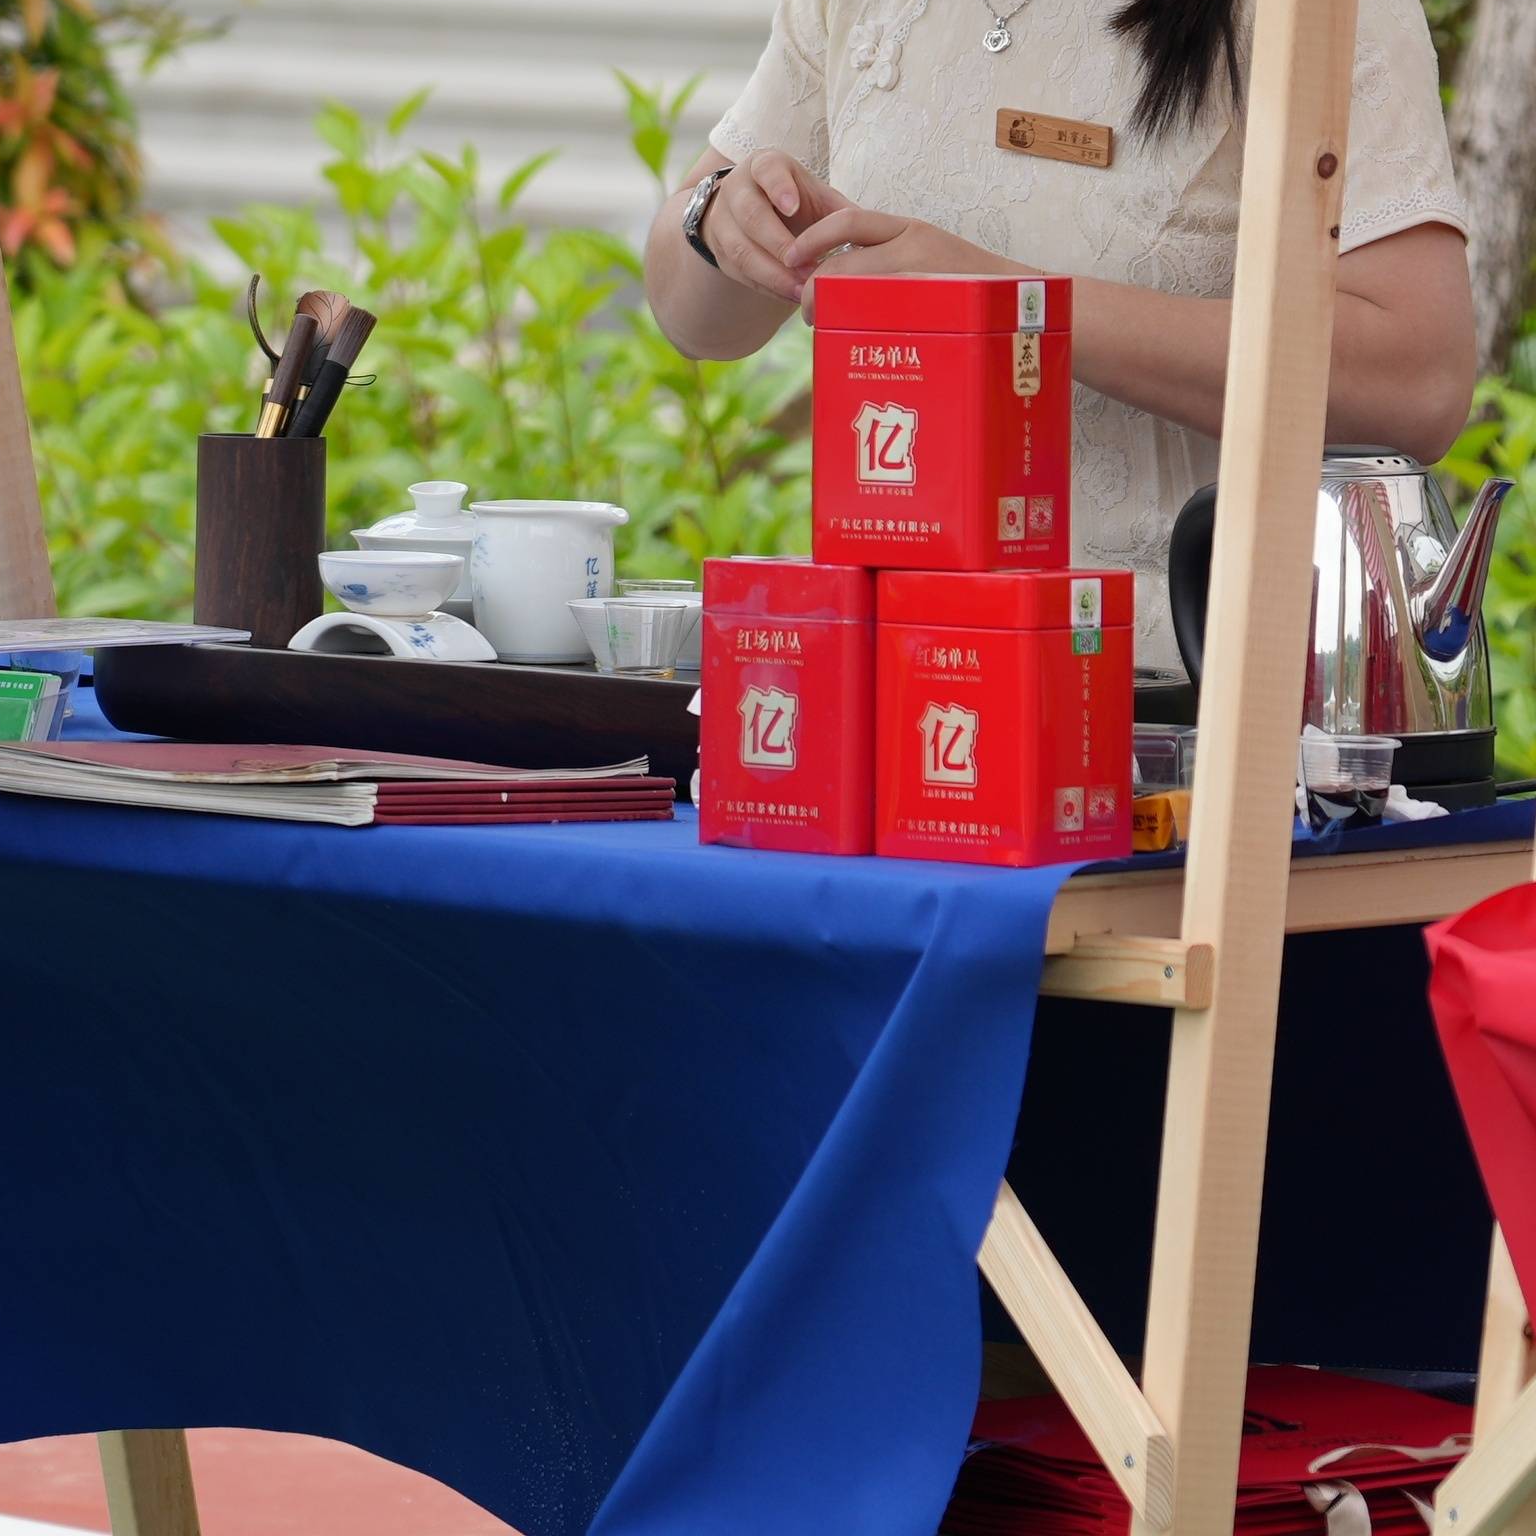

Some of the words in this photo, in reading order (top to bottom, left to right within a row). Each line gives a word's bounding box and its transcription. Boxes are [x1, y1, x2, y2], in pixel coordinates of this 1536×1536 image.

[850, 345, 921, 368] 红场单丛
[737, 629, 802, 653] 红场单丛
[915, 647, 980, 670] 红场单丛
